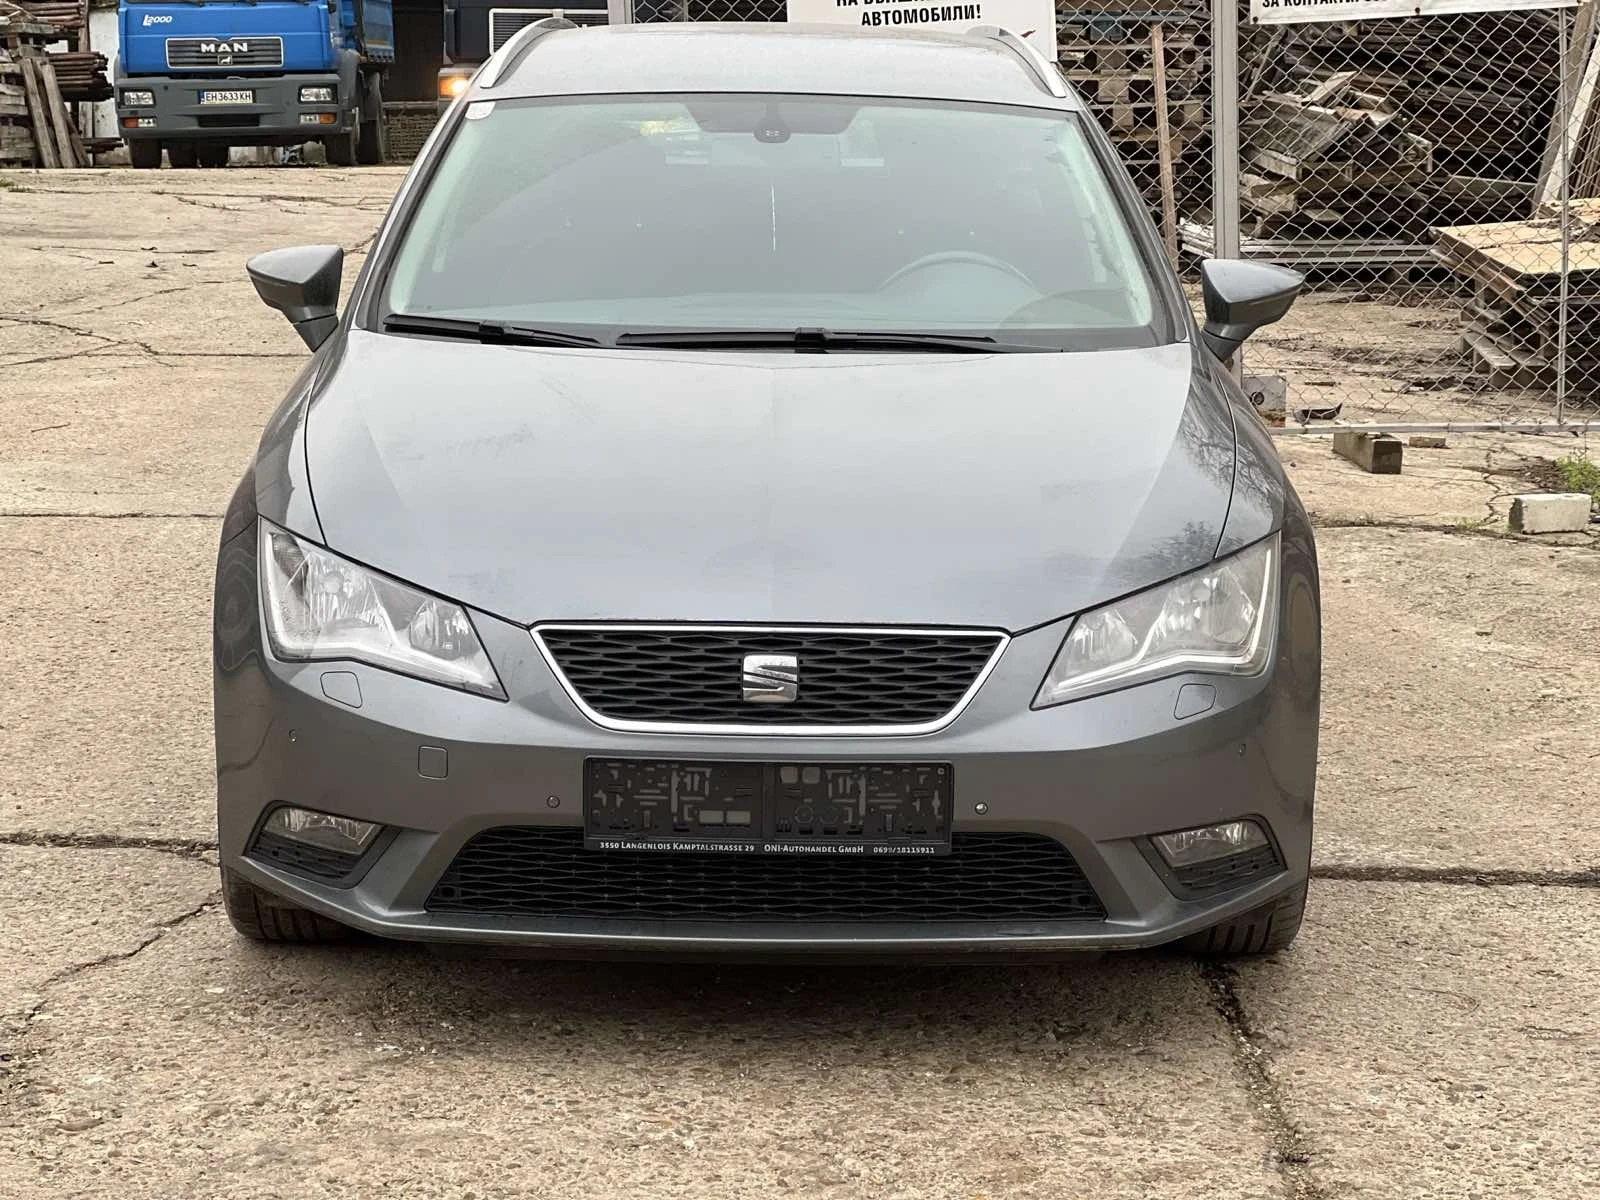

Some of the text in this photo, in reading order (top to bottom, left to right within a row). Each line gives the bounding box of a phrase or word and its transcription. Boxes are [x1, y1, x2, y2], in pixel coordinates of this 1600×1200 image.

[142, 14, 173, 26] L2000
[861, 4, 982, 26] АВТОМОБИЛИ!
[201, 42, 248, 53] MAN
[600, 841, 620, 849] 3550
[744, 844, 755, 852] 29
